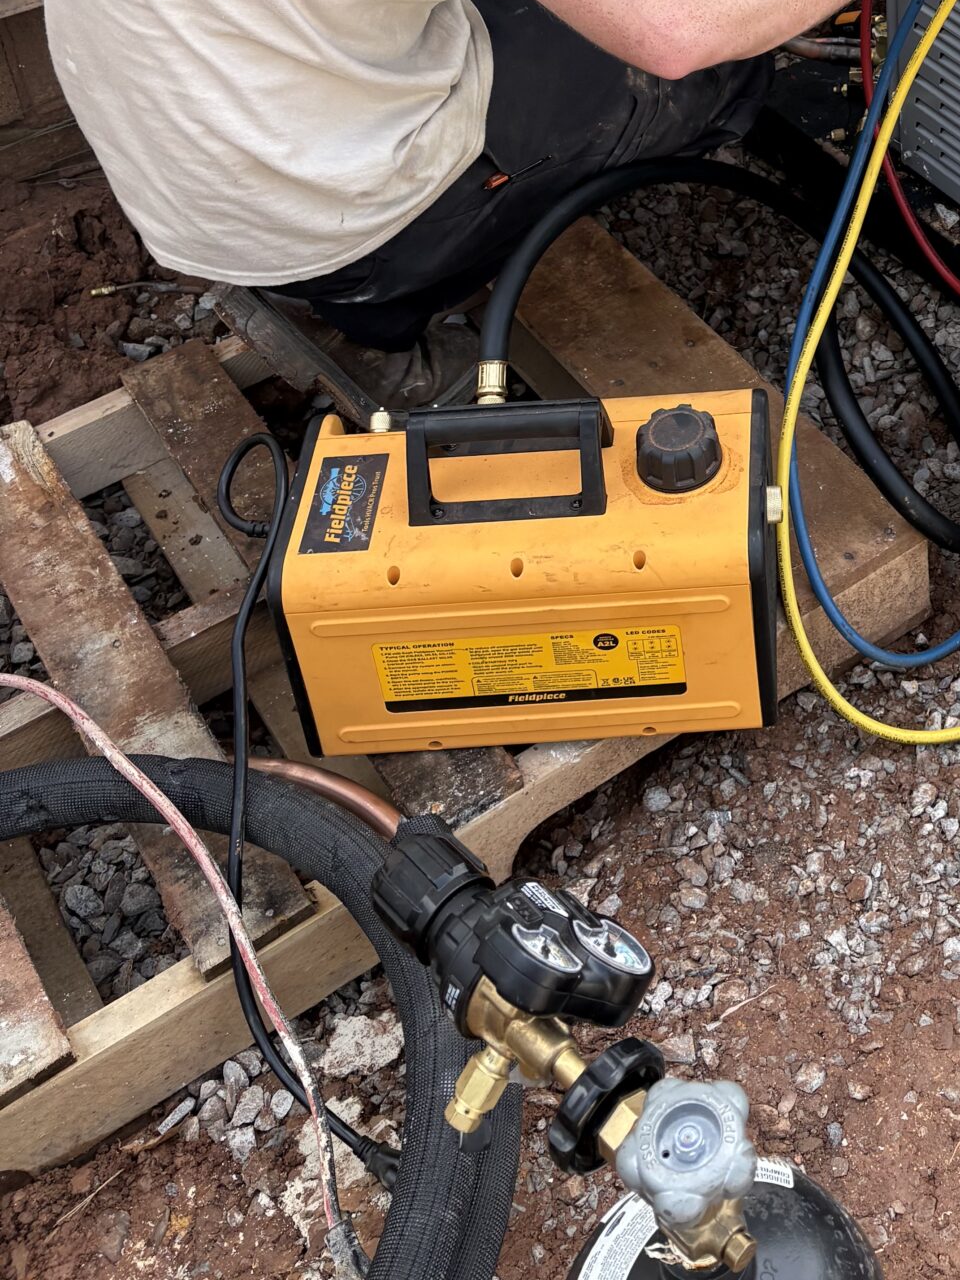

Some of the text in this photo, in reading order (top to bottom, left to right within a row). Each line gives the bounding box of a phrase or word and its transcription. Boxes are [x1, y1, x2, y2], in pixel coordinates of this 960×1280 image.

[324, 464, 358, 543] Fieldpiece
[365, 497, 375, 517] HVACR
[362, 517, 371, 532] Tools
[379, 644, 410, 652] TYPICAL
[508, 691, 566, 703] Fieldpiece
[719, 1104, 736, 1144] OPEN
[639, 1124, 657, 1171] CLOSE
[758, 1165, 790, 1179] COMPRE
